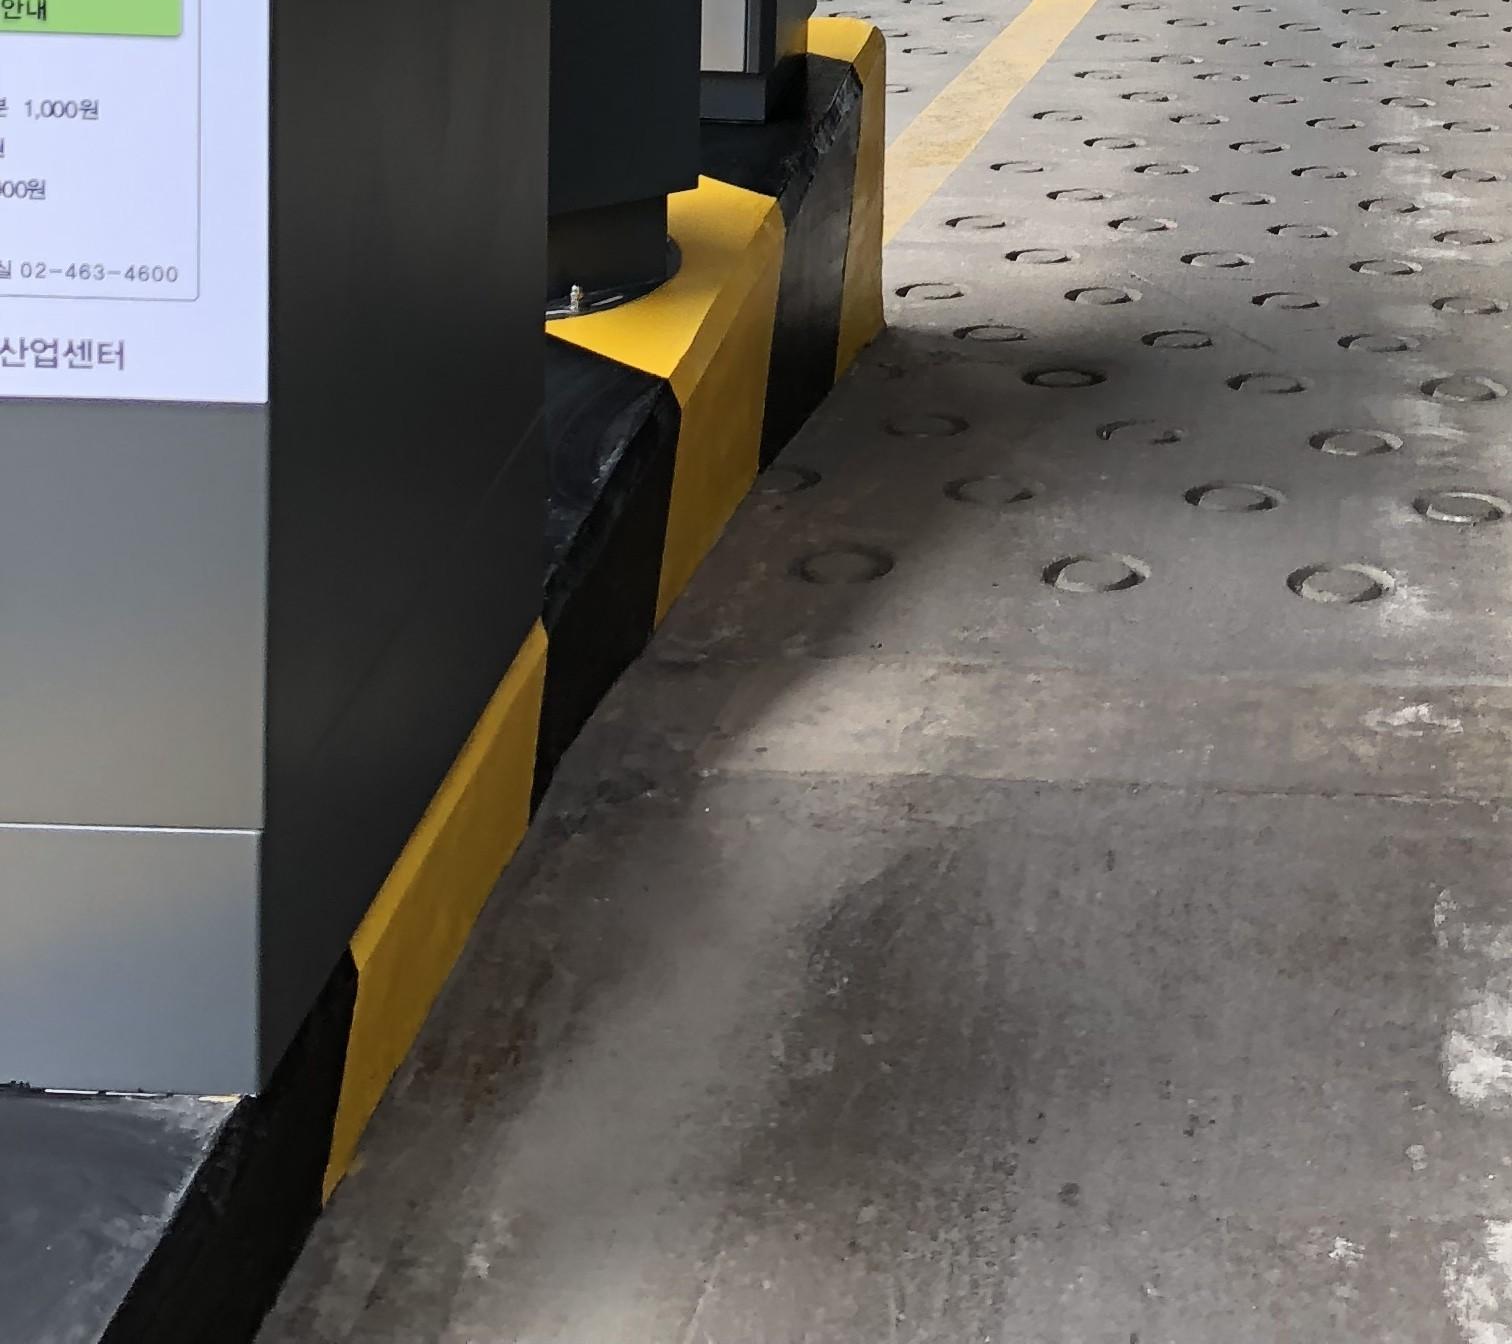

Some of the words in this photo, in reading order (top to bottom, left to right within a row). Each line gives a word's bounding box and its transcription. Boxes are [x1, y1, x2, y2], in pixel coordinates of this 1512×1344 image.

[24, 99, 99, 120] 1,000원
[0, 179, 46, 200] 00원
[20, 263, 179, 283] 02-463-4600
[0, 337, 125, 371] 산업센터
